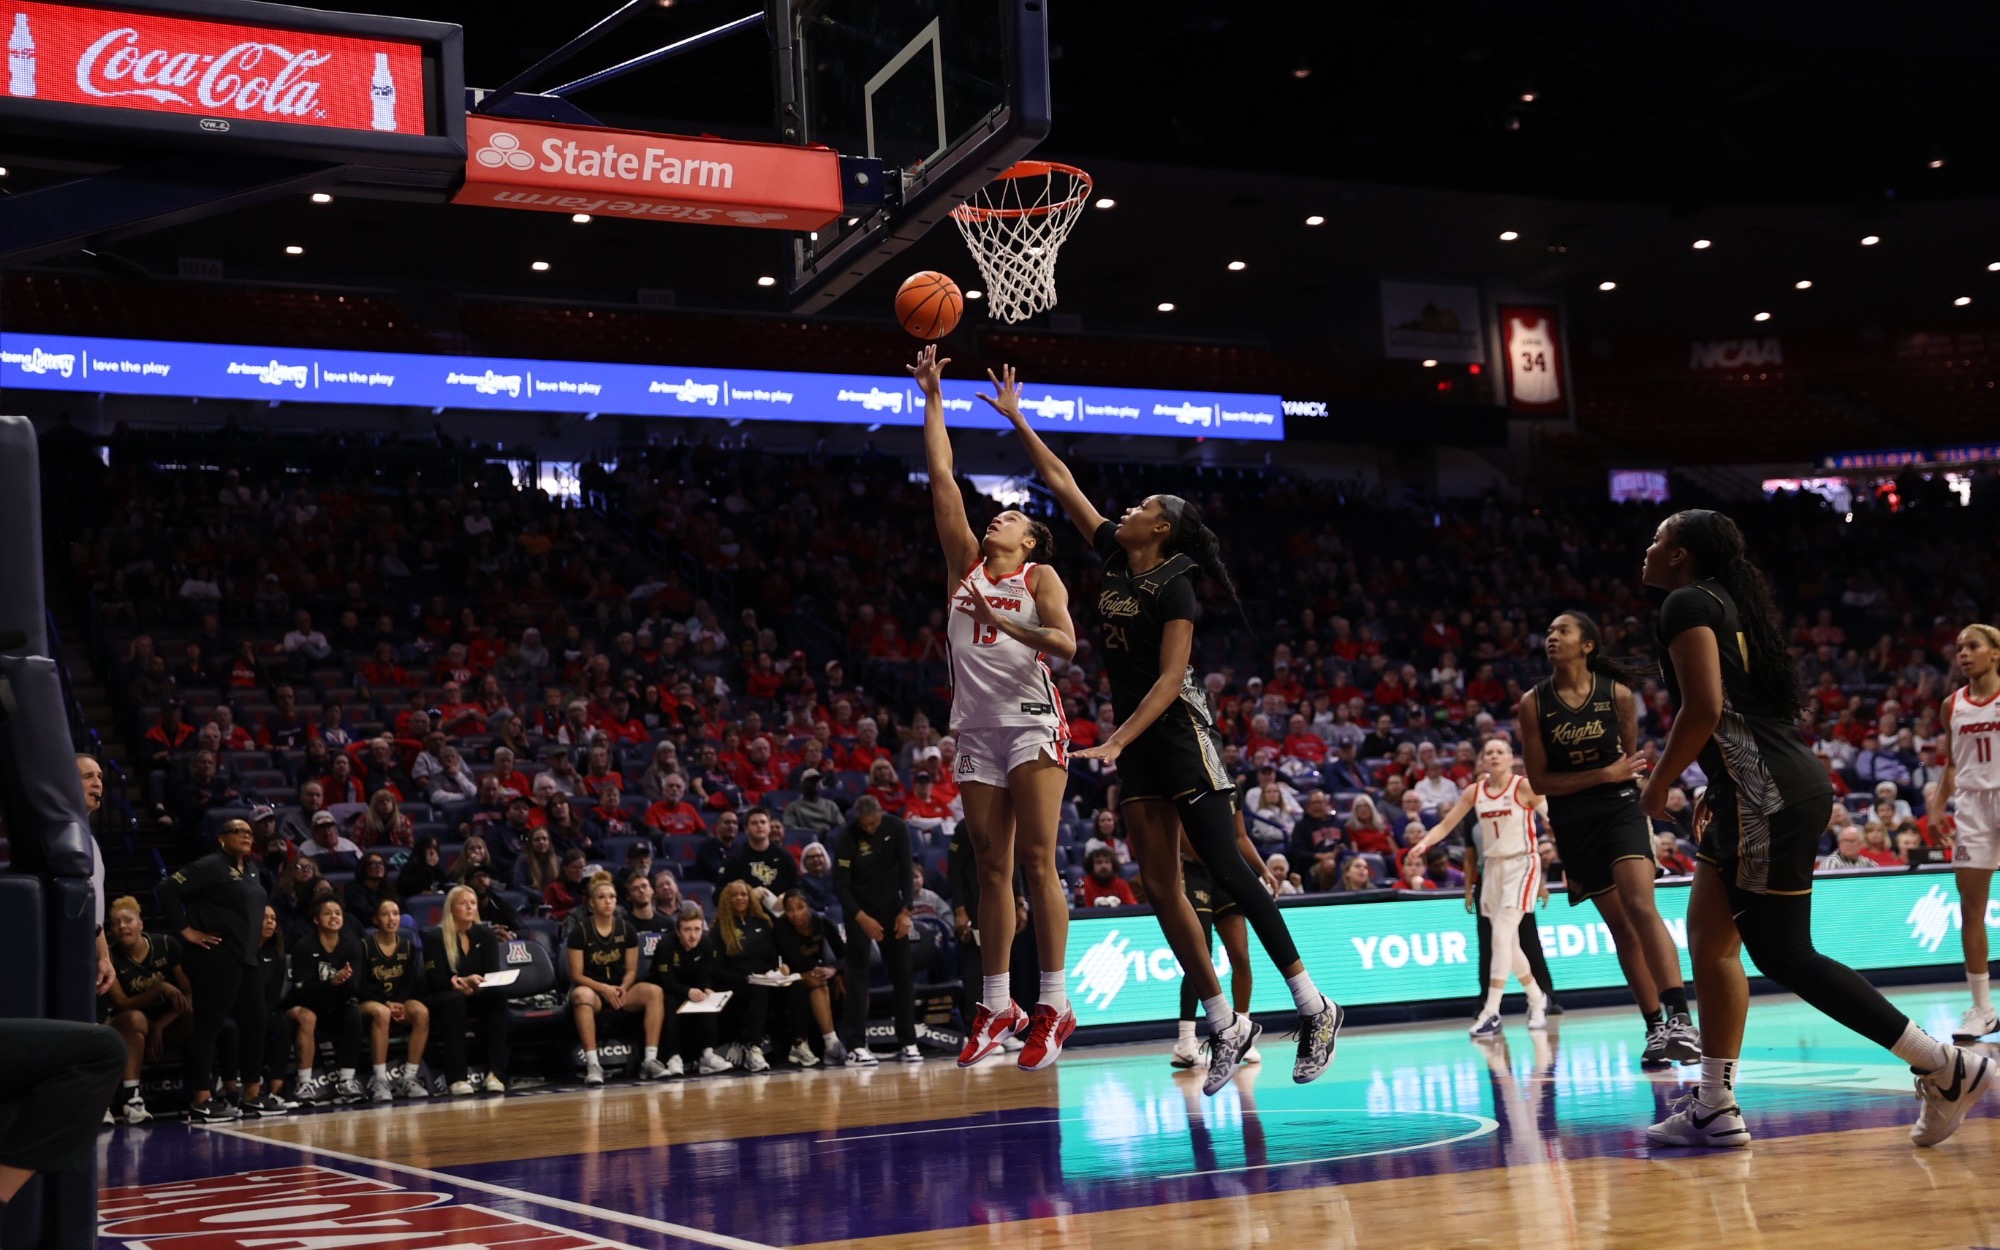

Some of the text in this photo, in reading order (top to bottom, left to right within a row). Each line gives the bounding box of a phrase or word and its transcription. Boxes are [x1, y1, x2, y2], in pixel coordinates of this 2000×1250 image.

[76, 27, 332, 119] Coca-Cola
[540, 137, 734, 188] State Farm
[121, 360, 140, 373] the
[1522, 352, 1547, 372] 34
[1690, 337, 1784, 370] NCAA
[1098, 590, 1140, 618] Knights
[1103, 622, 1129, 652] 24
[1552, 720, 1607, 745] Knights
[1976, 737, 1992, 763] 11
[1493, 821, 1499, 838] 1
[1351, 931, 1468, 970] YOUR
